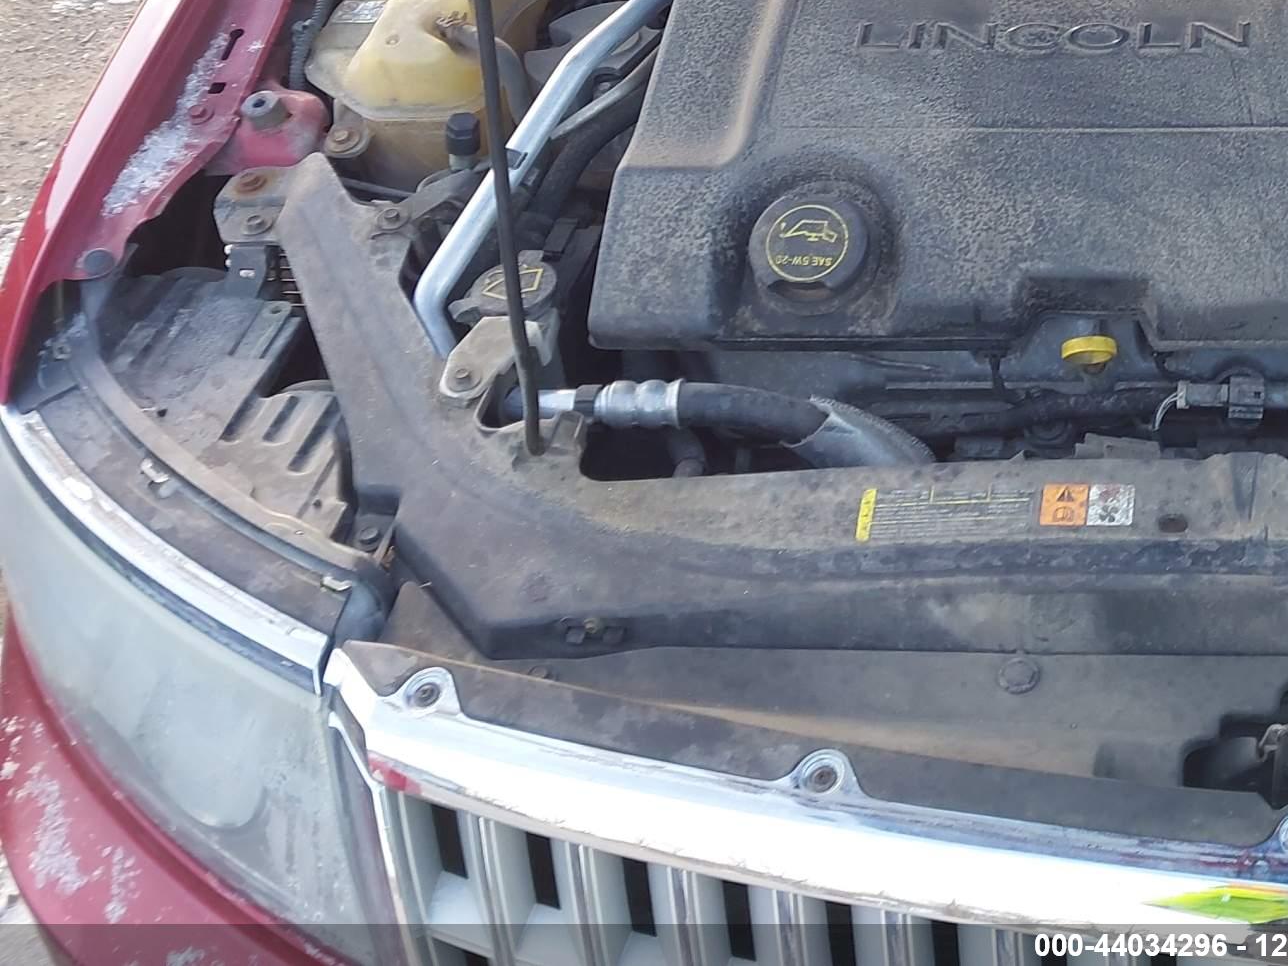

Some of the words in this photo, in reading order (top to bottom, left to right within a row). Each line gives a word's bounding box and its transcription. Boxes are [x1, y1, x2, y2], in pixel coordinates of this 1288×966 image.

[855, 21, 1251, 51] LINCOLN
[775, 254, 809, 266] 5W-20
[810, 255, 833, 267] SAE
